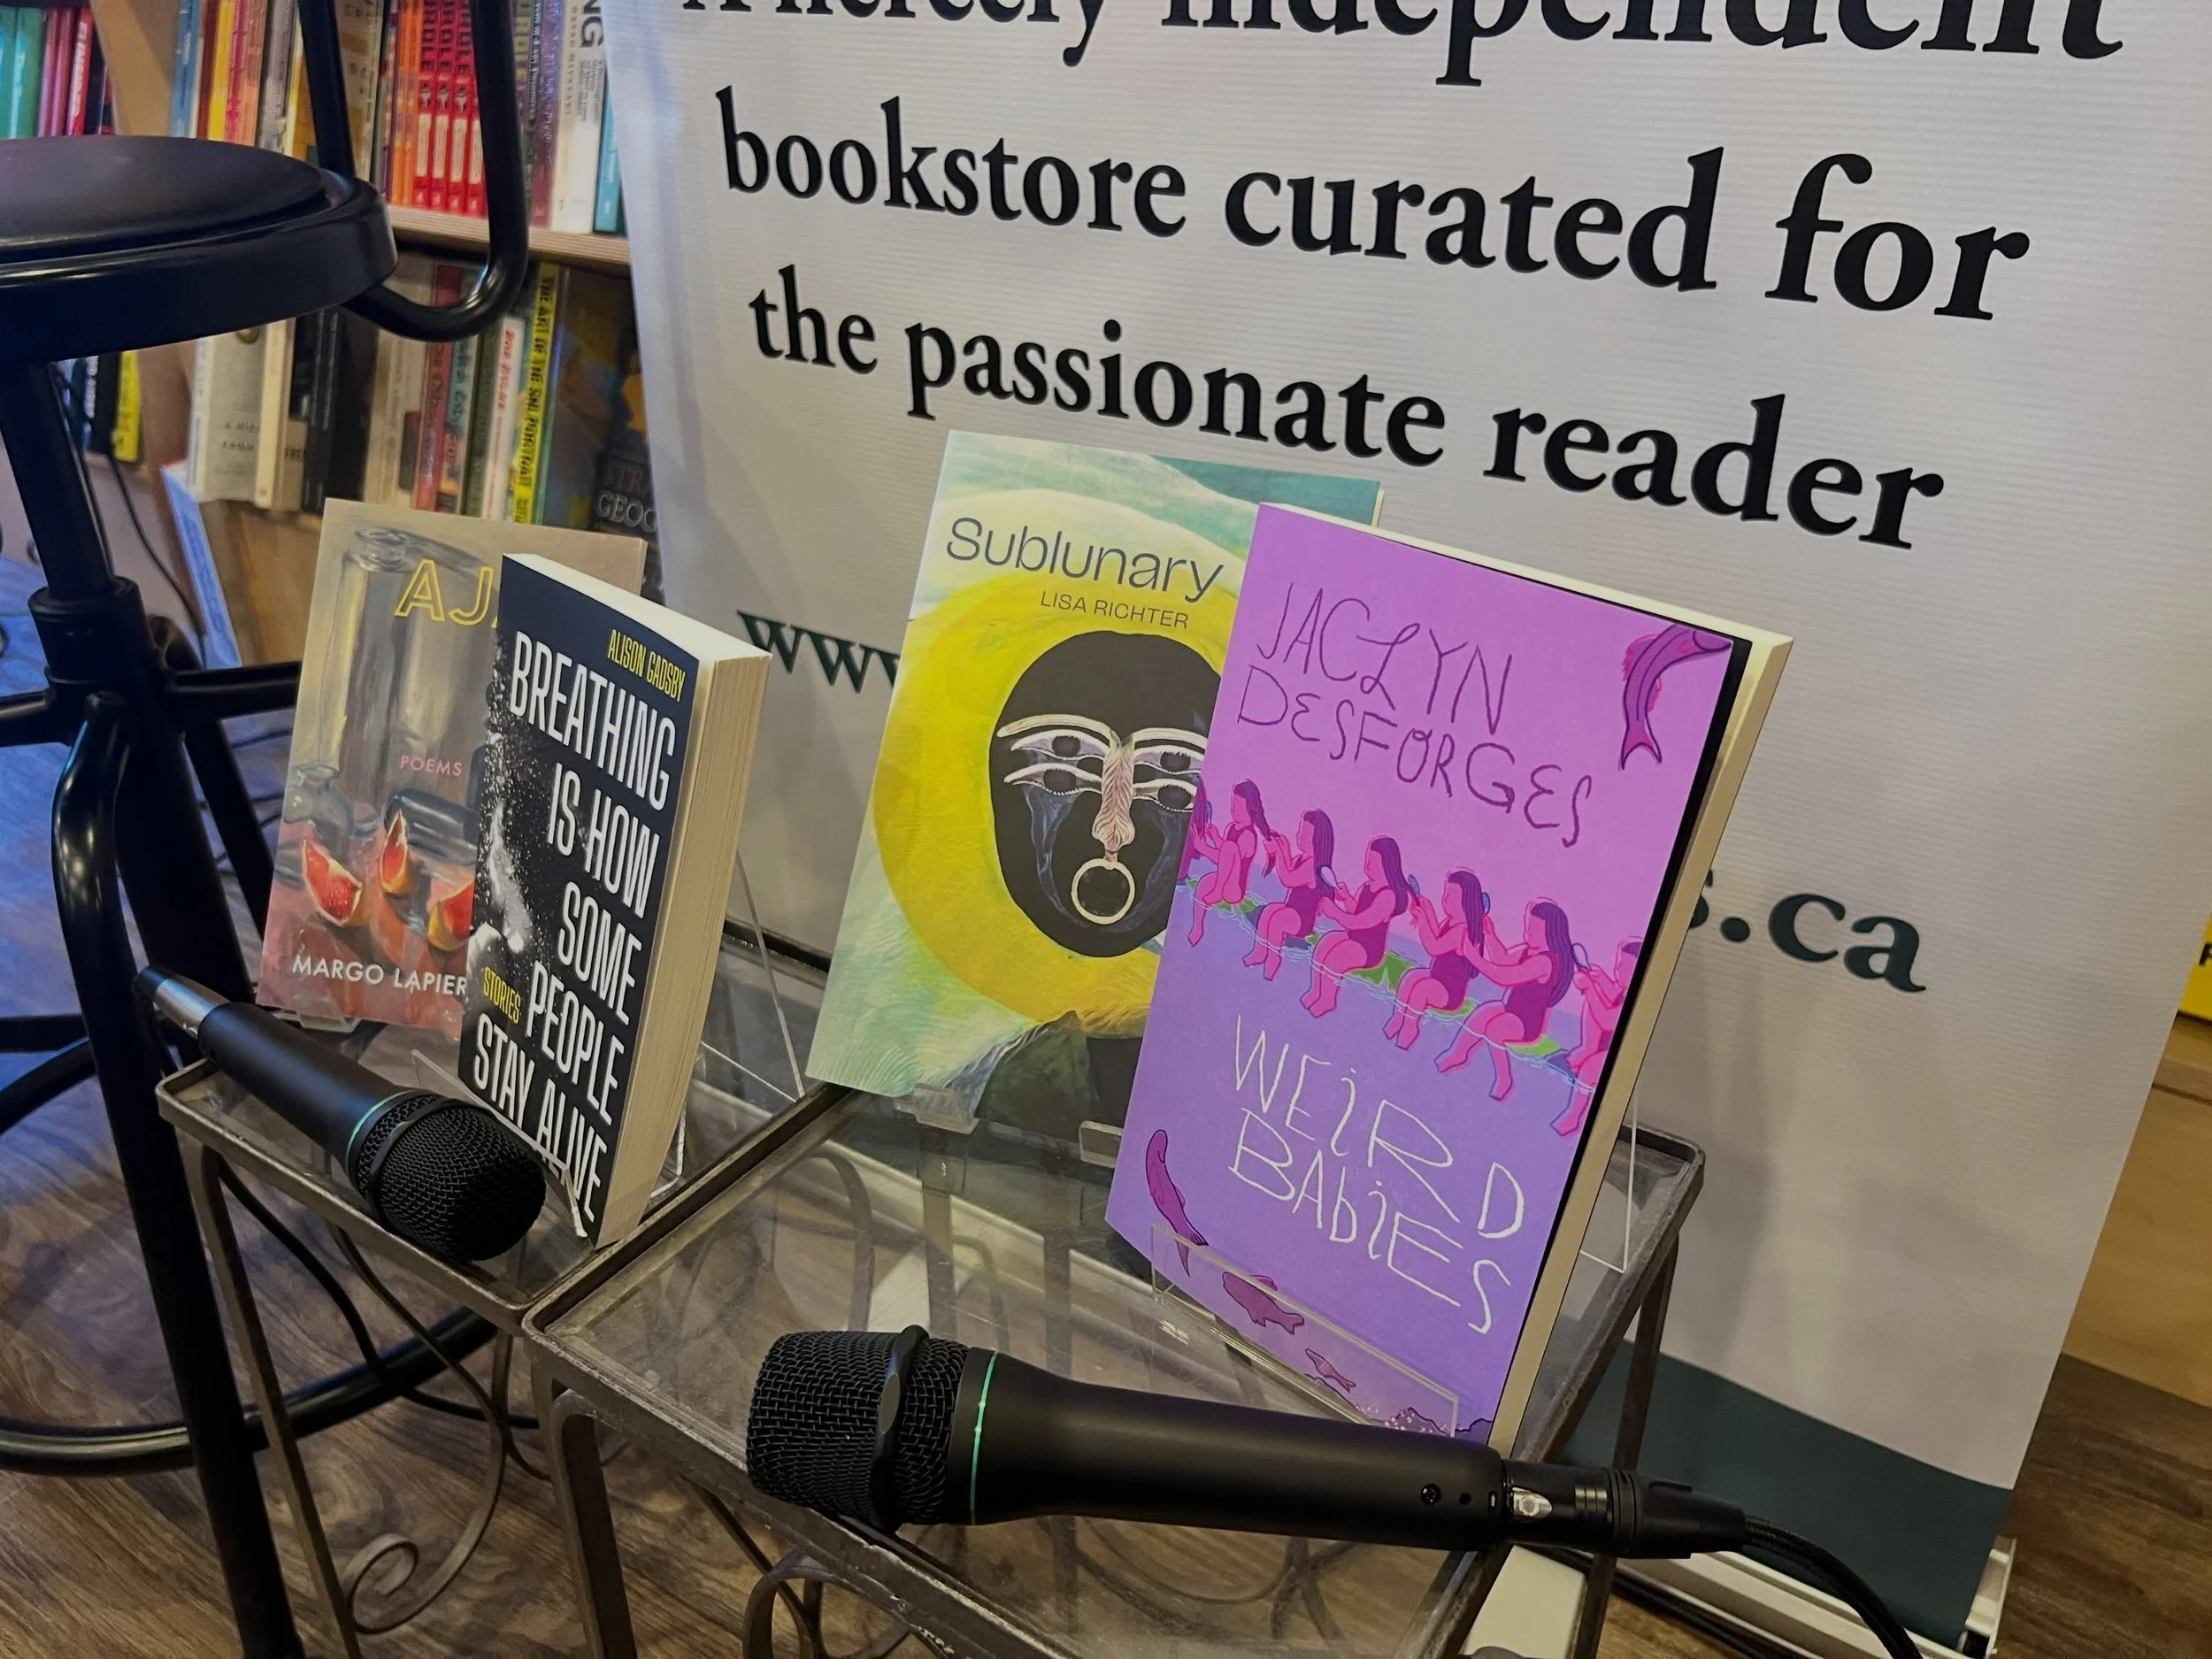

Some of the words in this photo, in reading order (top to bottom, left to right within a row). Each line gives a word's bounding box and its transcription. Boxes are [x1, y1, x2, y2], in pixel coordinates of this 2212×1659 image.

[714, 85, 1187, 238] bookstore
[1225, 146, 1724, 293] curated
[1765, 153, 2031, 320] for
[749, 265, 878, 374] the
[904, 319, 1446, 467] passionate
[1483, 394, 1944, 550] reader
[395, 558, 498, 628] AJ
[946, 517, 1224, 603] Sublunary
[1041, 590, 1087, 613] LISA
[1094, 599, 1189, 630] RICHTER
[509, 630, 677, 811] BREATHING
[607, 629, 646, 677] ALISON
[646, 652, 687, 703] GADSBY
[1257, 581, 1512, 735] JACLYN
[400, 755, 463, 778] POEMS
[1238, 664, 1591, 849] DESFORGES
[548, 763, 580, 856] IS
[585, 789, 660, 919] HOW
[292, 954, 384, 986] MARGO
[393, 968, 467, 995] LAPIER
[482, 966, 522, 1025] STORIES
[558, 881, 641, 1025] SOME
[526, 960, 625, 1126] PEOPLE
[474, 1013, 536, 1130] STAY
[535, 1078, 607, 1223] ALIVE
